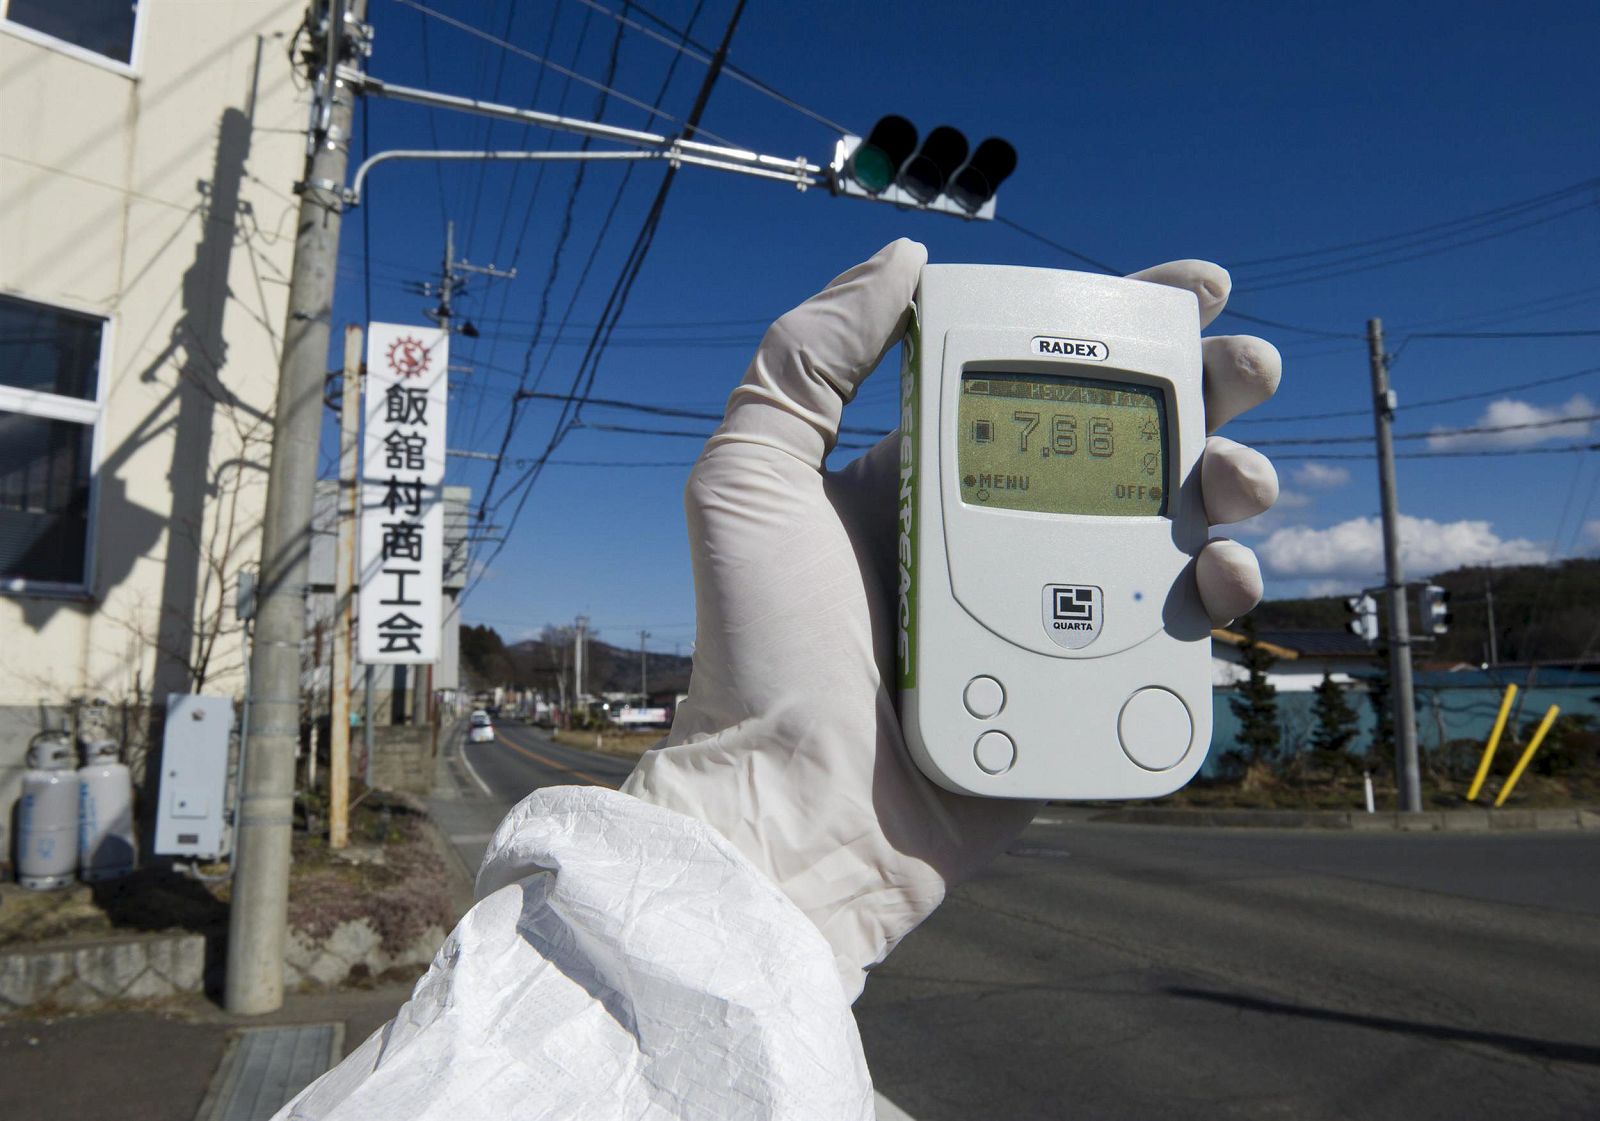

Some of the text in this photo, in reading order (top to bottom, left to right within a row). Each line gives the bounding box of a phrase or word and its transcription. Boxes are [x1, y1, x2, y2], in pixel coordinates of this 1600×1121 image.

[1039, 340, 1098, 357] RADEX
[1014, 411, 1114, 457] 7.66
[898, 331, 914, 675] GREENPEACE
[979, 473, 1147, 500] MENU OFF
[378, 383, 429, 654] 飯舘村商工会
[1053, 621, 1093, 631] QUARTA
